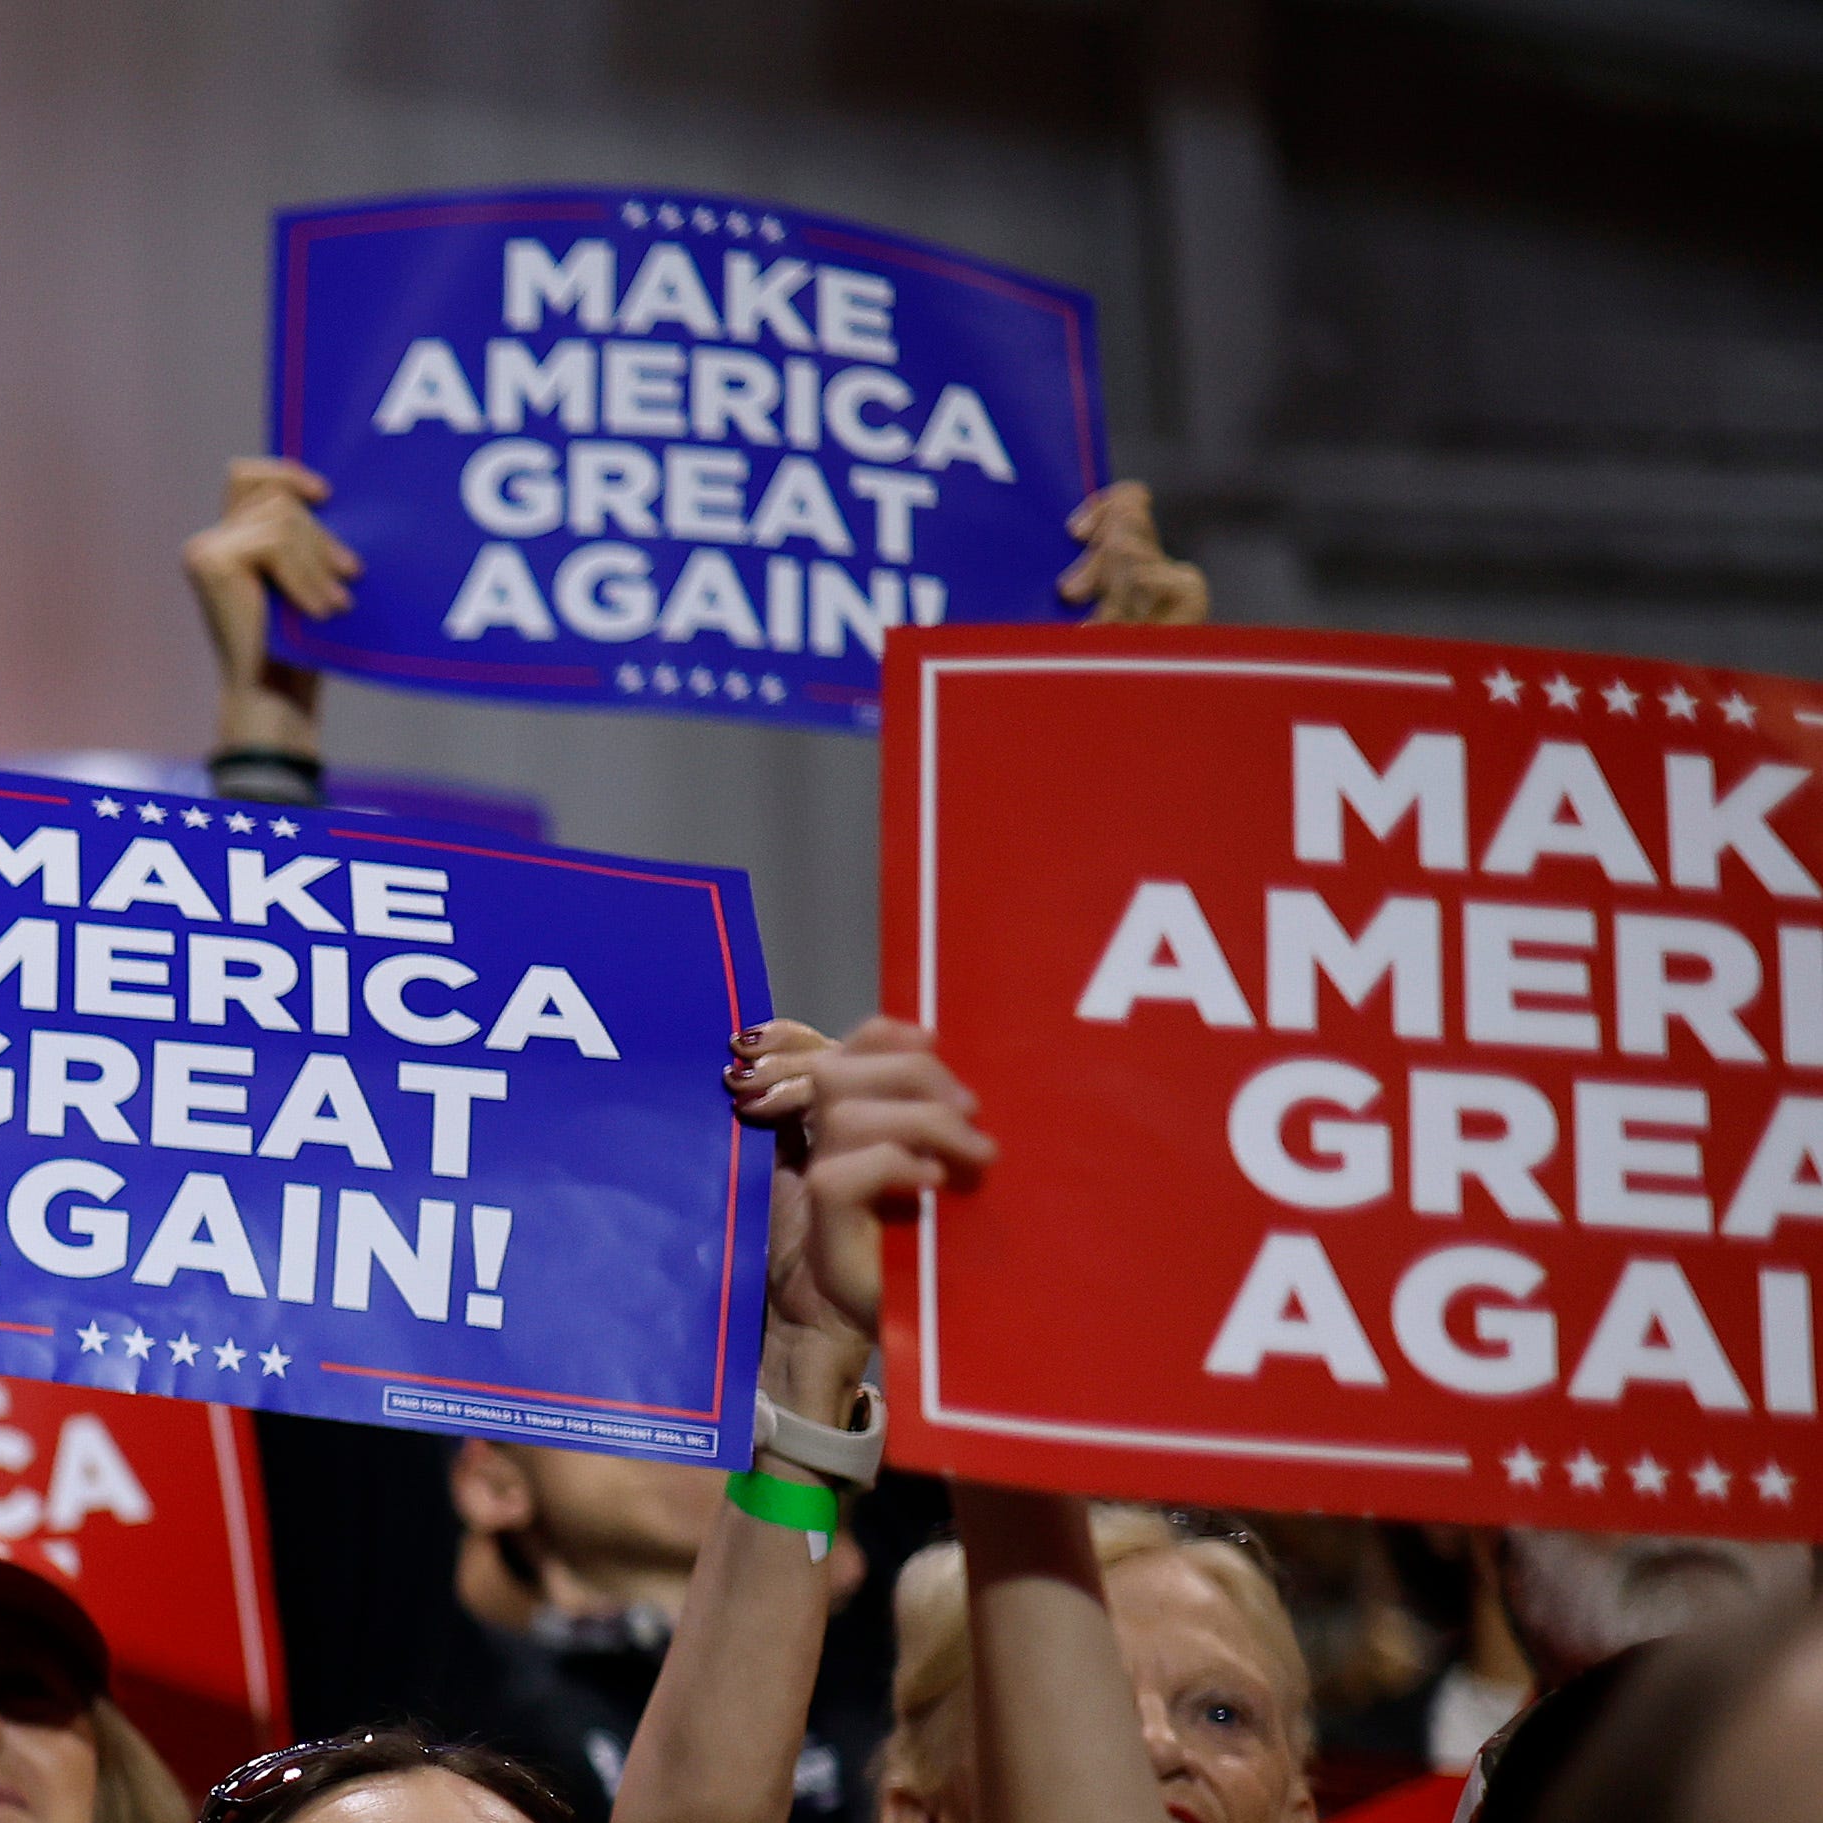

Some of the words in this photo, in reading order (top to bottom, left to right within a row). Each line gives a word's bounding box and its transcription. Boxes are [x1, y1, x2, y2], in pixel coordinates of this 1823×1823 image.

[505, 240, 896, 362] MAKE
[374, 340, 1011, 479] AMERICA
[462, 439, 935, 562] GREAT
